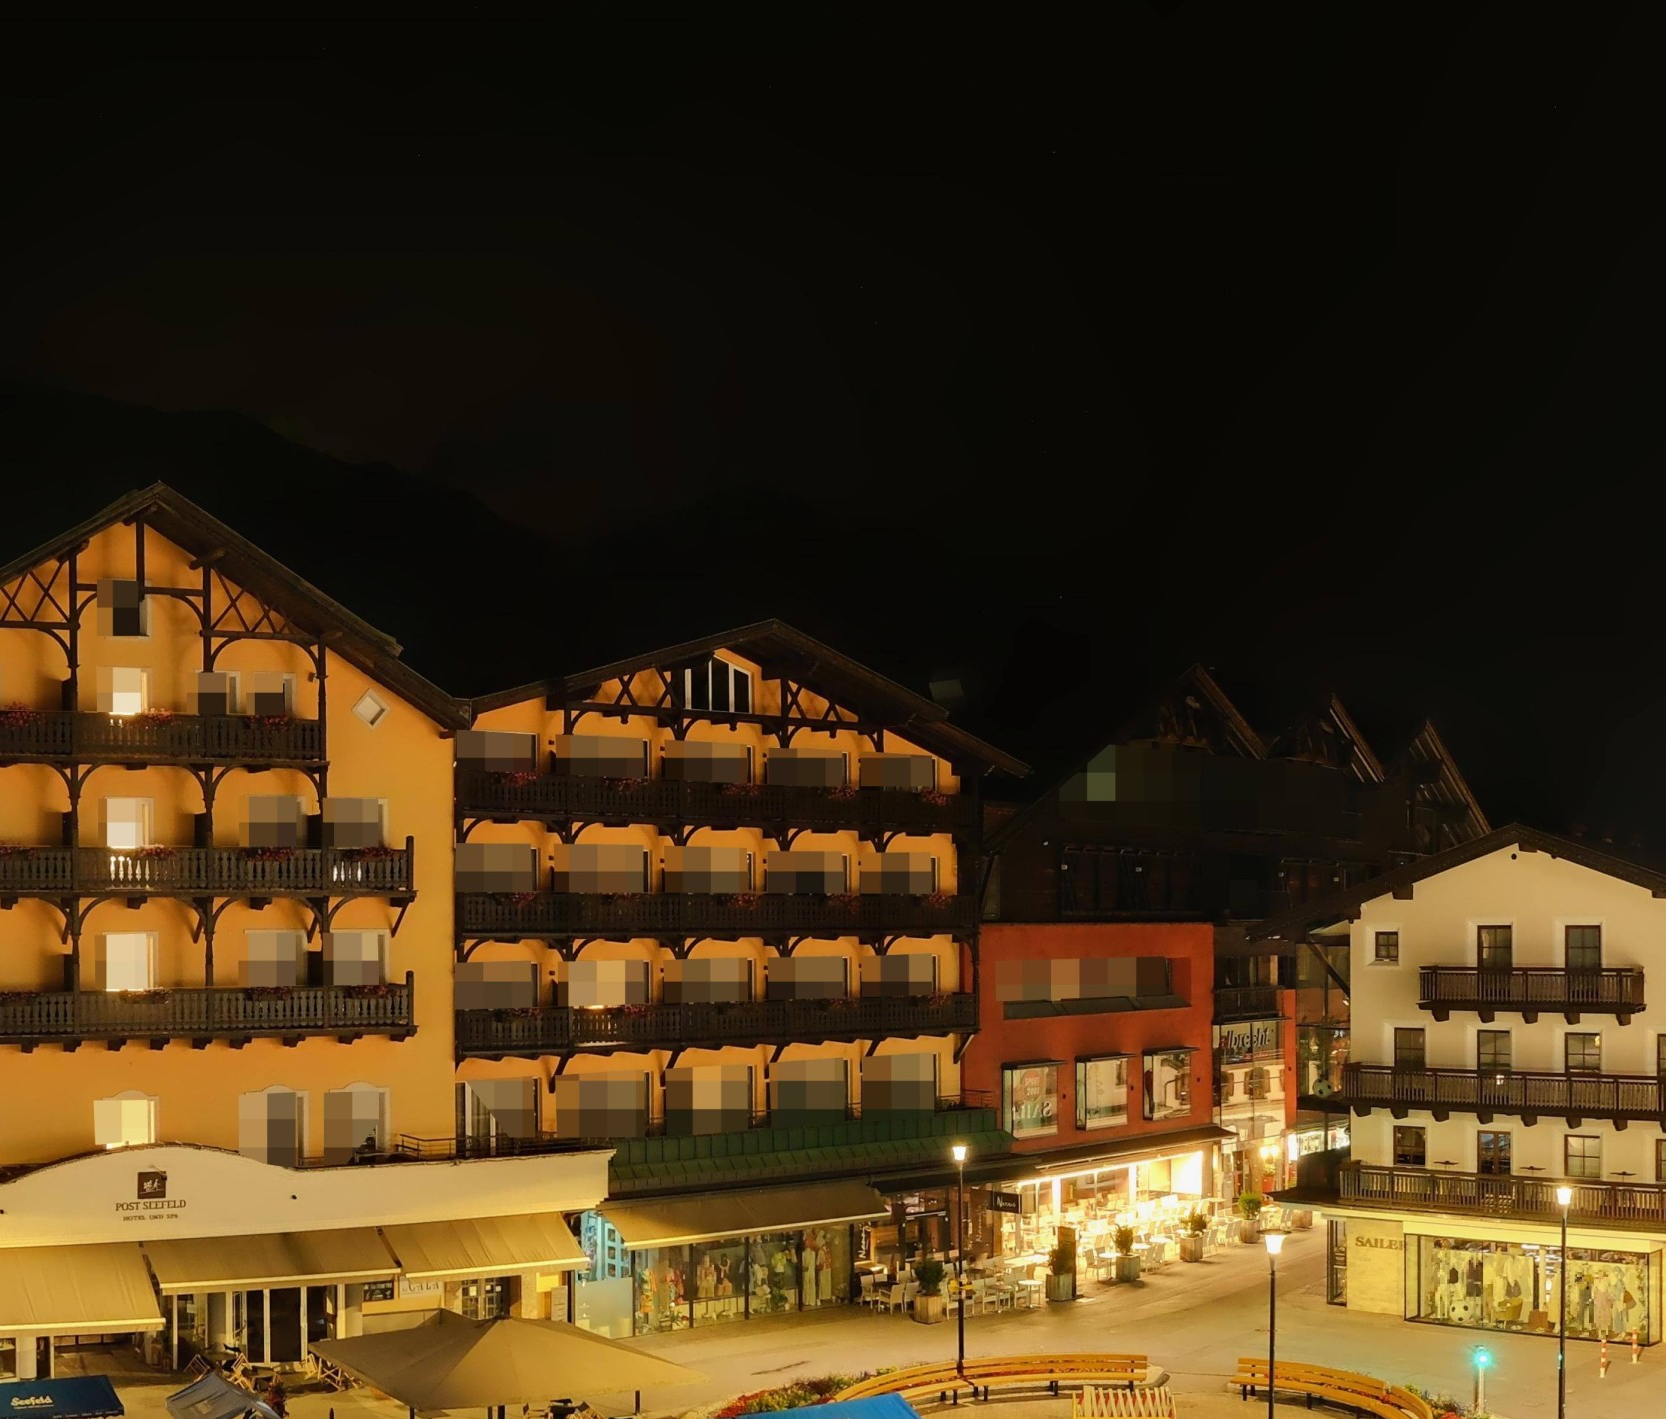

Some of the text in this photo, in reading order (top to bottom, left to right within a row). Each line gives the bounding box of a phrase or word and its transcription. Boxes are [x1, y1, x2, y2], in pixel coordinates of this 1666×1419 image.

[116, 1200, 187, 1212] POST SEEFELD
[10, 1395, 54, 1407] Seefeld
